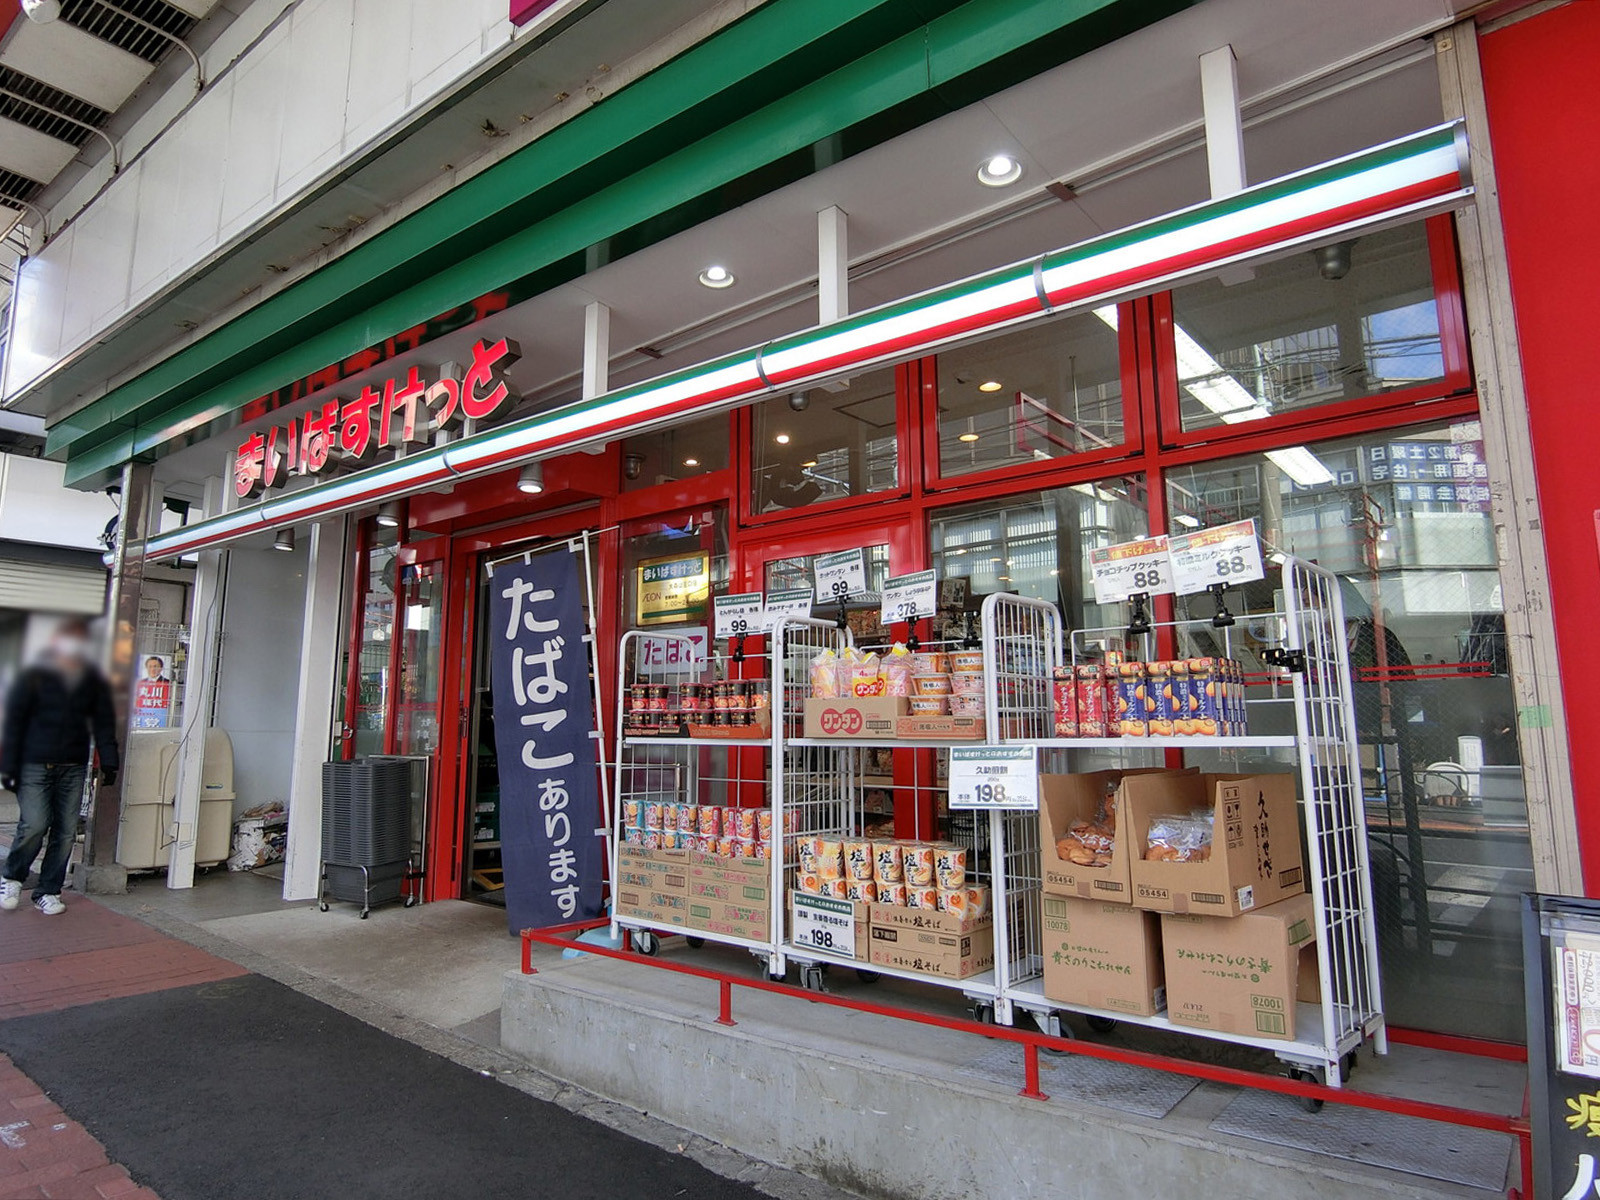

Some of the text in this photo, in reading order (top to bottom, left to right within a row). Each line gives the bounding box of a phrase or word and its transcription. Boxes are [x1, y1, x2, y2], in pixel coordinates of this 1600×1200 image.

[234, 336, 513, 498] まいばすけっと
[1096, 558, 1168, 578] チョコチップクッキー
[1215, 555, 1246, 577] 88
[831, 580, 849, 596] 99
[1133, 569, 1161, 589] 88
[731, 619, 748, 633] 99
[643, 634, 705, 666] たばこ
[823, 711, 862, 731] ワンタン
[501, 576, 583, 920] たばこあります
[975, 765, 1009, 775] 久助煎餅
[974, 783, 1006, 803] 198
[1048, 874, 1074, 885] 05454
[1139, 888, 1168, 899] 05454
[1046, 920, 1069, 931] 10078
[811, 928, 833, 948] 198
[1252, 996, 1282, 1010] 10078
